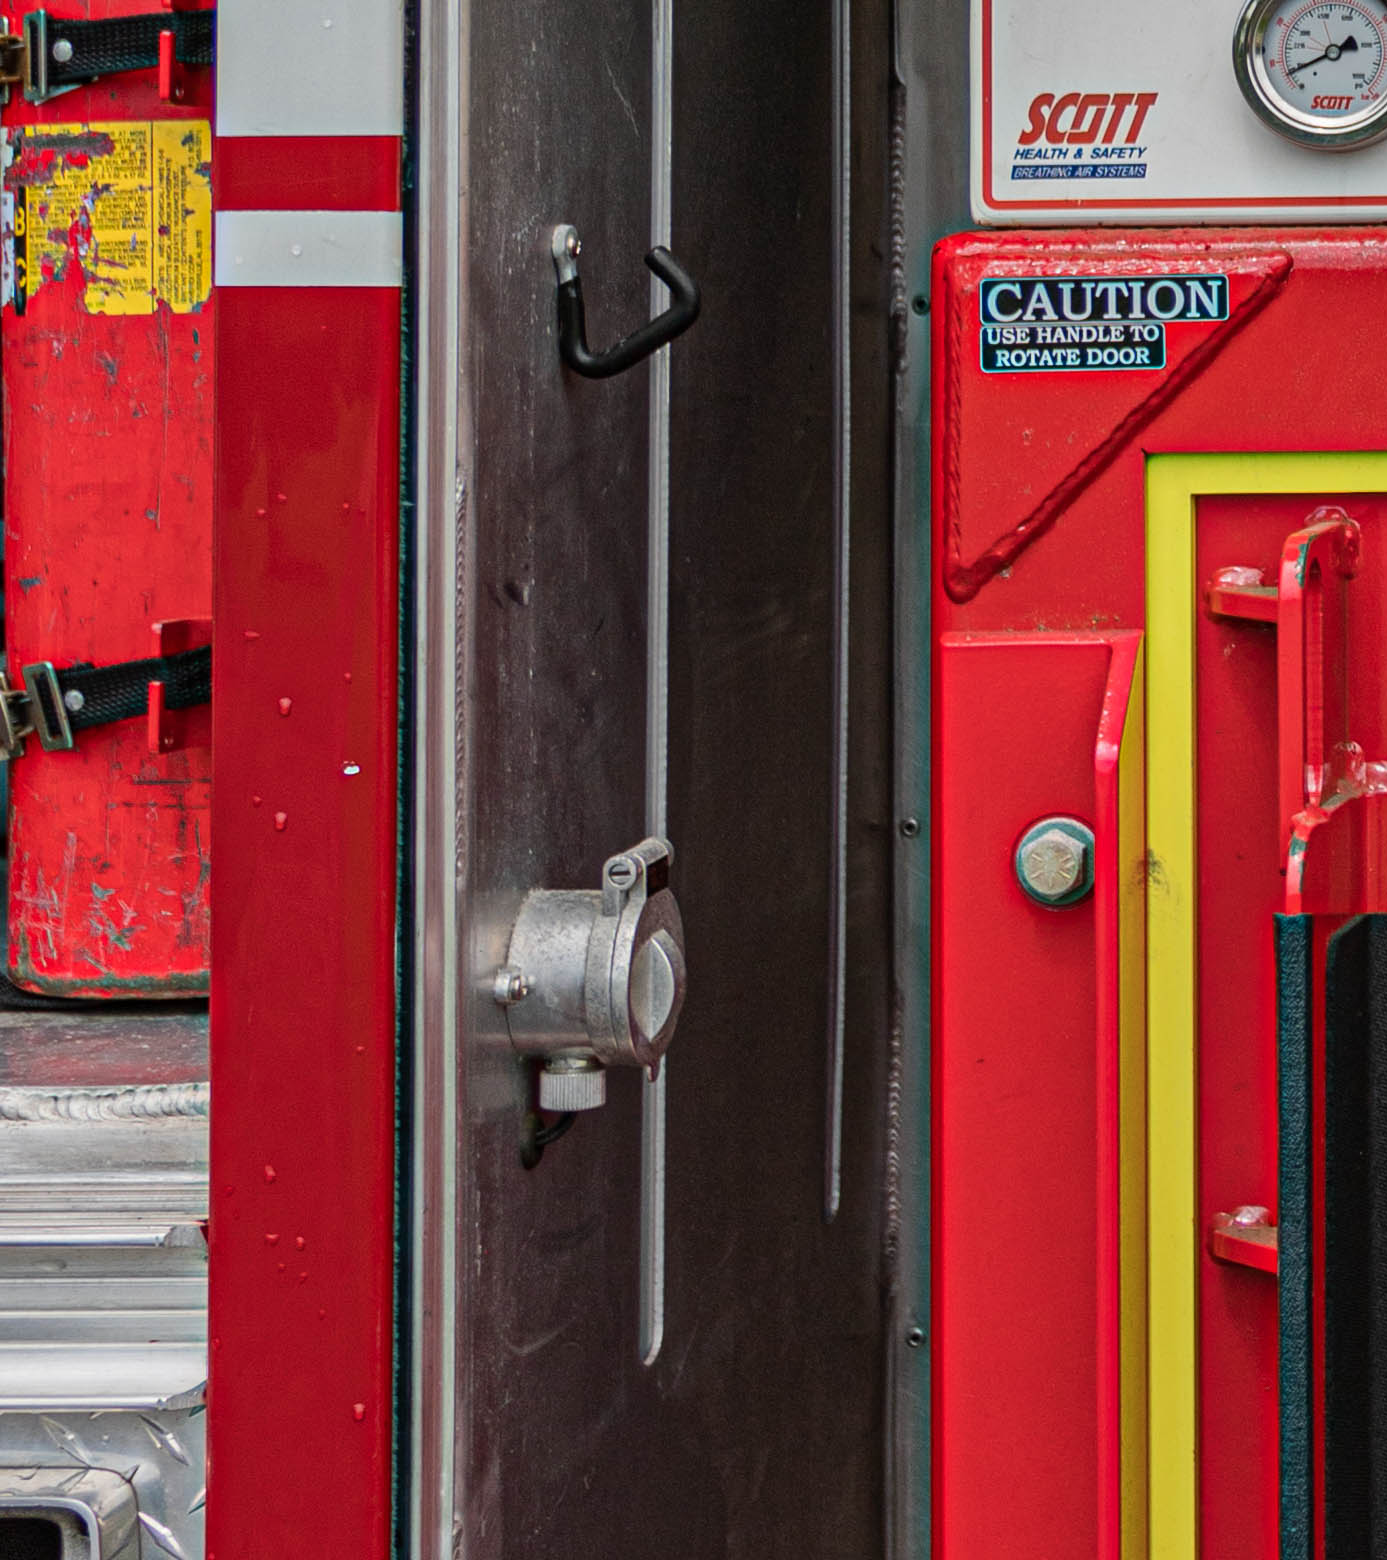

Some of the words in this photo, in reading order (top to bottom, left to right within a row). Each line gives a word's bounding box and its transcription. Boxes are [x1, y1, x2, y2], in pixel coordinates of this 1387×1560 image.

[1310, 95, 1355, 110] SCOTT
[1018, 92, 1158, 145] SCOTT
[1014, 148, 1069, 160] HEALTH
[1073, 148, 1083, 159] &
[1090, 147, 1147, 159] SAFETY
[1013, 166, 1072, 179] BREATHING
[1075, 166, 1093, 177] AIR
[1095, 165, 1146, 177] SYSTEMS
[986, 279, 1222, 322] CAUTION
[986, 327, 1030, 344] USE
[1036, 326, 1124, 344] HANDLE
[1129, 324, 1160, 342] TO
[995, 349, 1081, 368] ROTATE
[1086, 347, 1151, 365] DOOR
